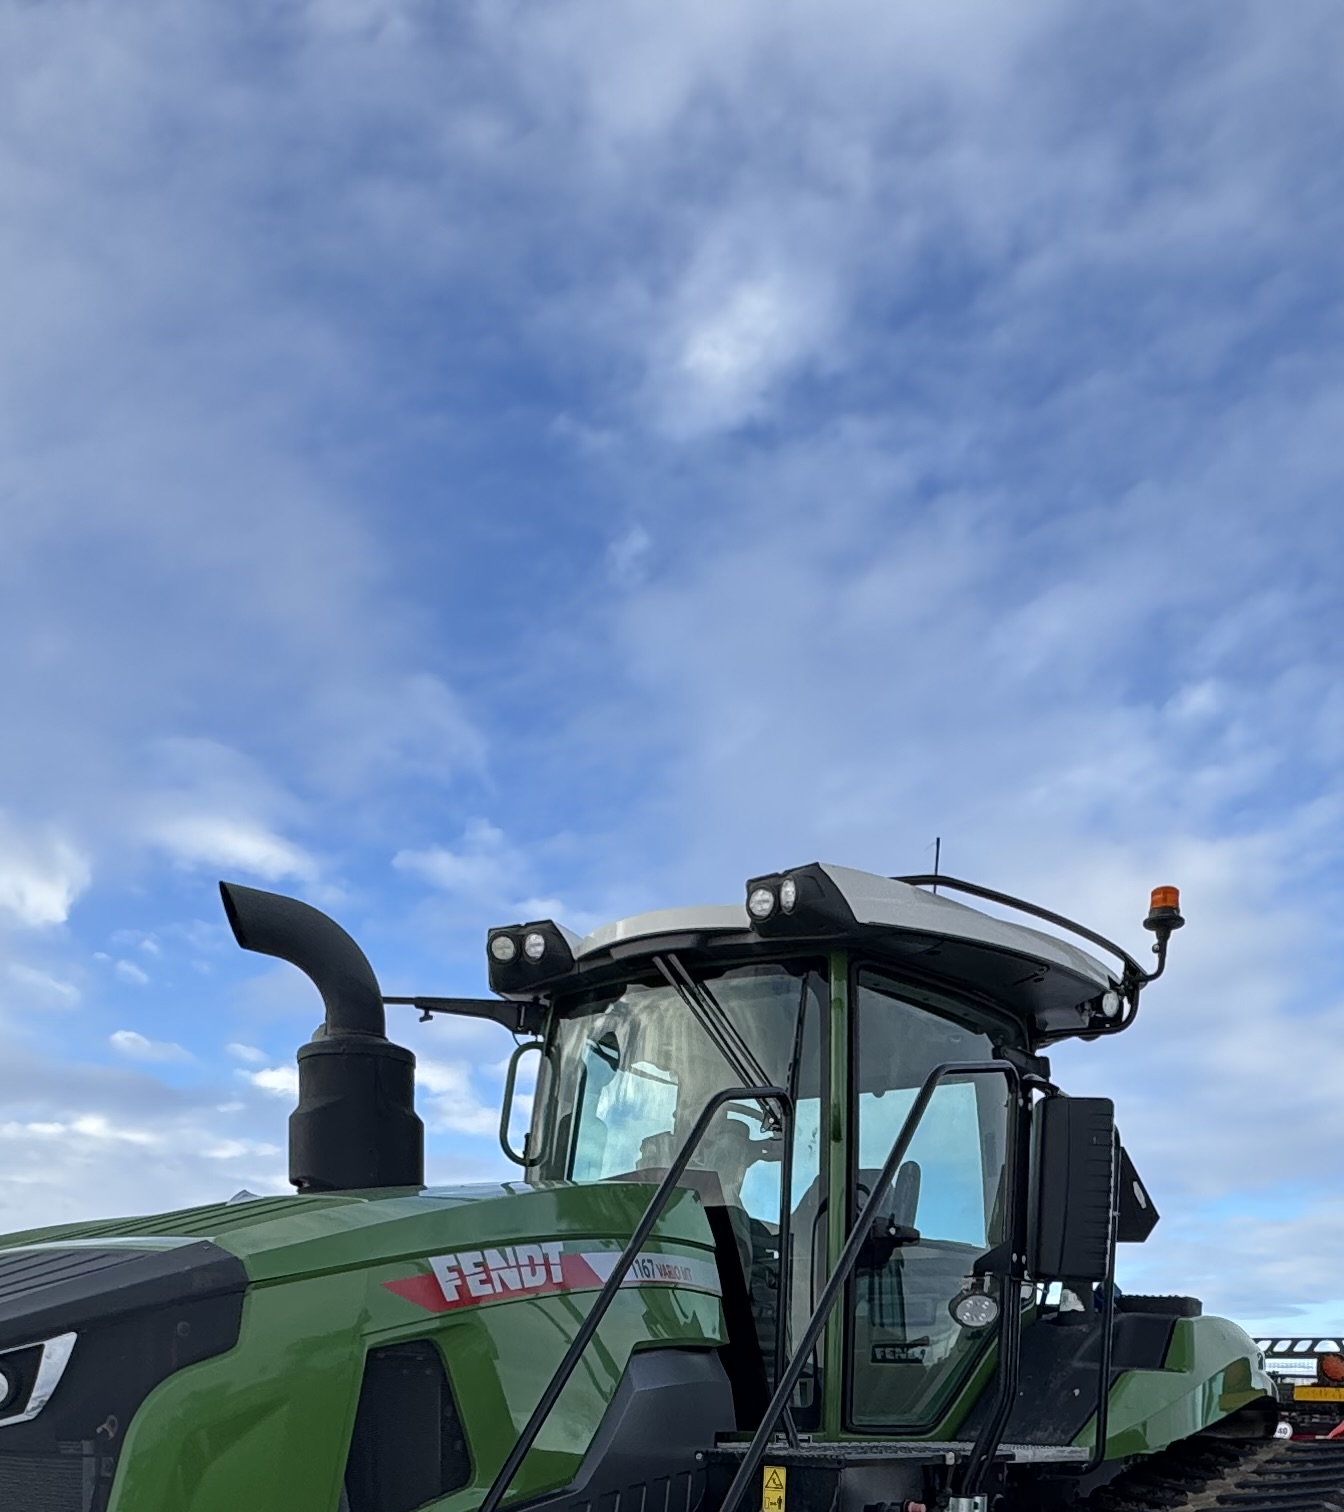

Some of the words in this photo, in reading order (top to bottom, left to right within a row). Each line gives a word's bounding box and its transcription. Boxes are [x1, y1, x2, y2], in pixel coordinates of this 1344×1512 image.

[428, 1242, 564, 1302] FENDT
[632, 1259, 656, 1279] 1167
[656, 1264, 681, 1281] VARIO
[1277, 1427, 1288, 1436] 40
